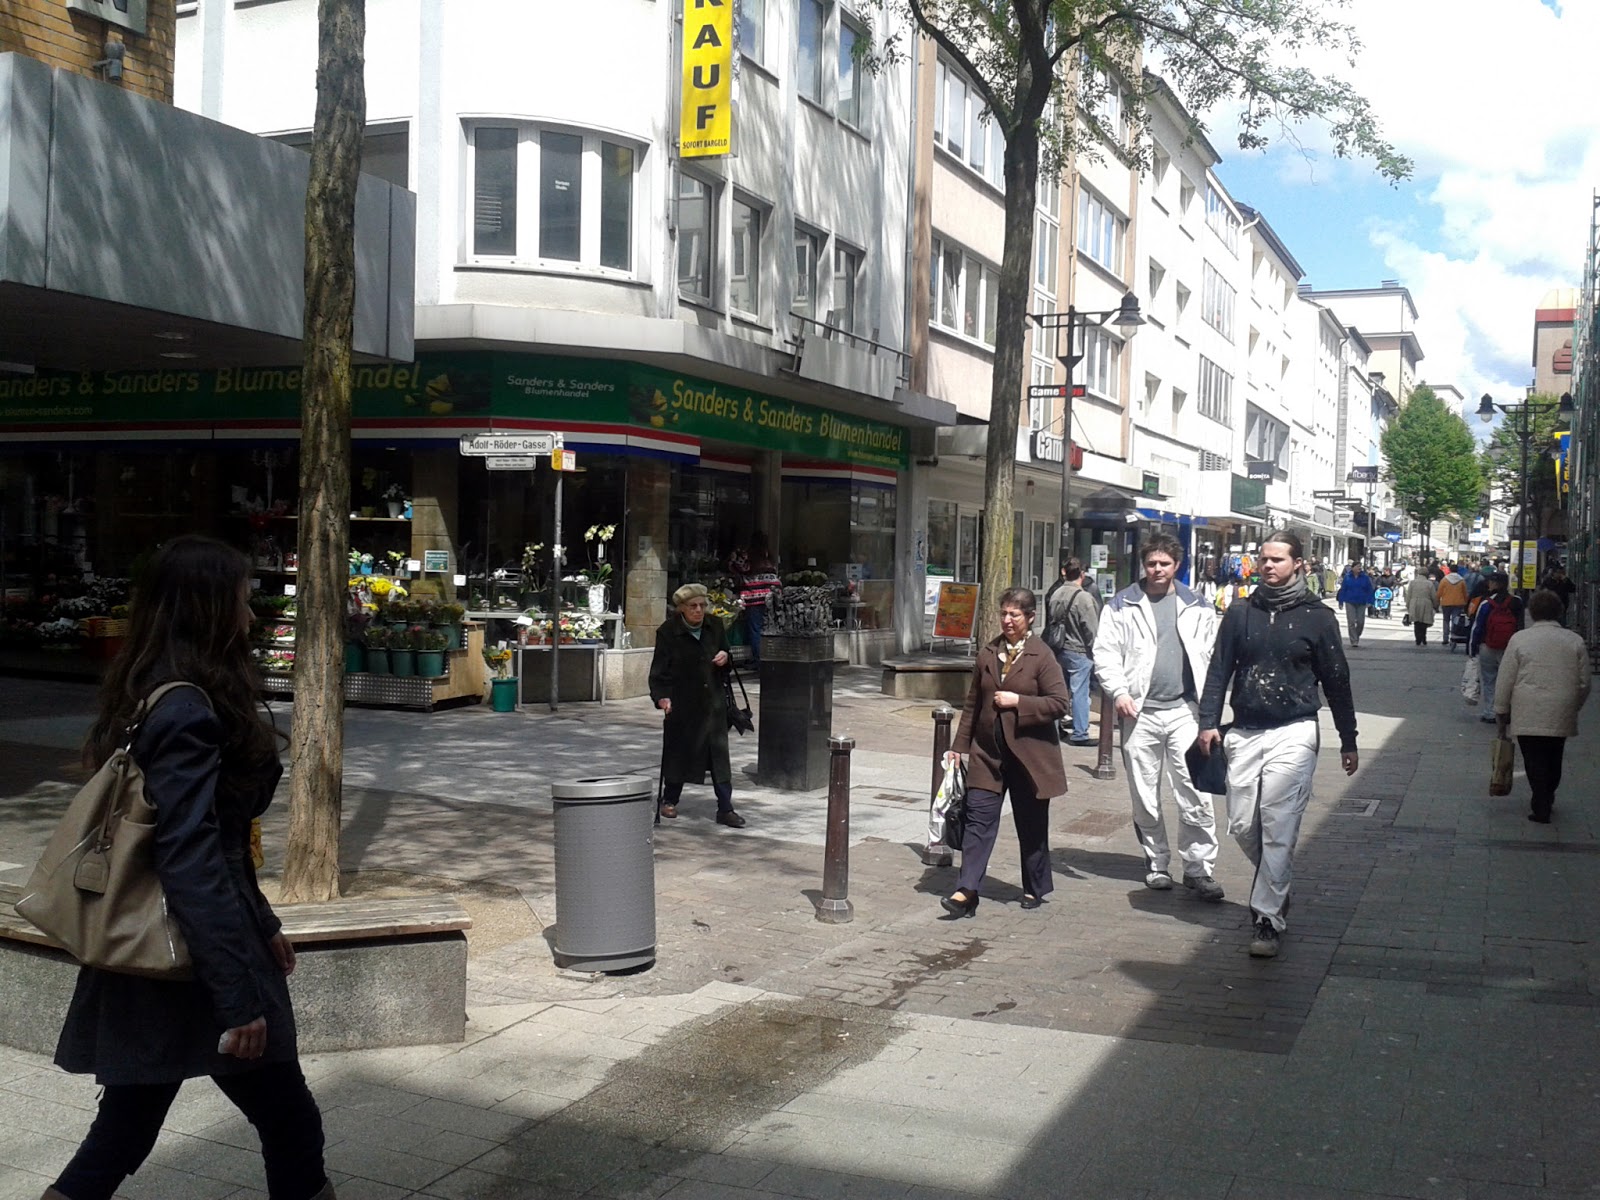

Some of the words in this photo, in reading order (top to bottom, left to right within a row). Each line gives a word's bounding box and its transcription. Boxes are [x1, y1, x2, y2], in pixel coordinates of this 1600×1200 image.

[682, 140, 703, 150] SOFORT
[703, 138, 728, 148] BARGELD
[0, 372, 71, 397] anders
[78, 370, 95, 395] &
[102, 369, 200, 395] Sanders
[215, 361, 421, 393] Blumendel
[507, 375, 554, 388] Sanders
[557, 378, 566, 389] &
[569, 379, 615, 392] Sanders
[524, 386, 590, 398] Blumenhandel
[1030, 386, 1084, 397] GameSop
[671, 379, 738, 420] Sanders
[743, 397, 754, 422] &
[758, 400, 813, 434] Sanders
[819, 413, 901, 451] Blumenhandel
[469, 440, 547, 450] Adolf-Röder-Gasse
